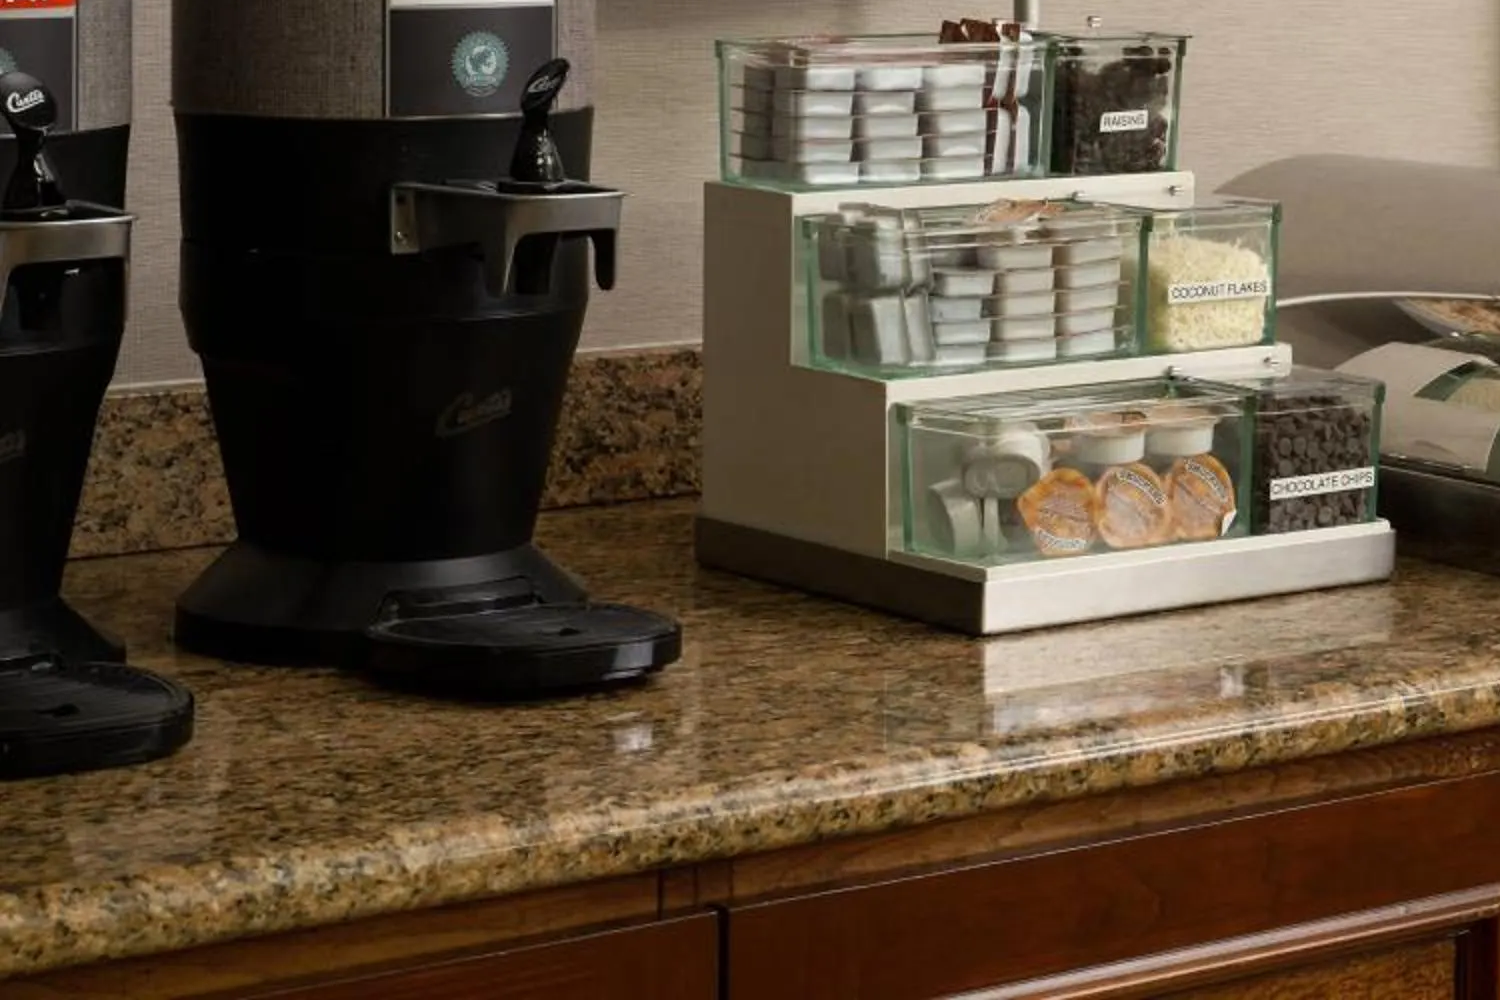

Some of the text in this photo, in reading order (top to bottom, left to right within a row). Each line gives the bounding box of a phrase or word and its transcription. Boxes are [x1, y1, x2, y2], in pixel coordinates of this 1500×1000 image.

[1103, 113, 1144, 126] RAISINS
[1172, 281, 1267, 299] COCONUT FLAKES
[1272, 471, 1372, 495] CHOCOLATE CHIPS
